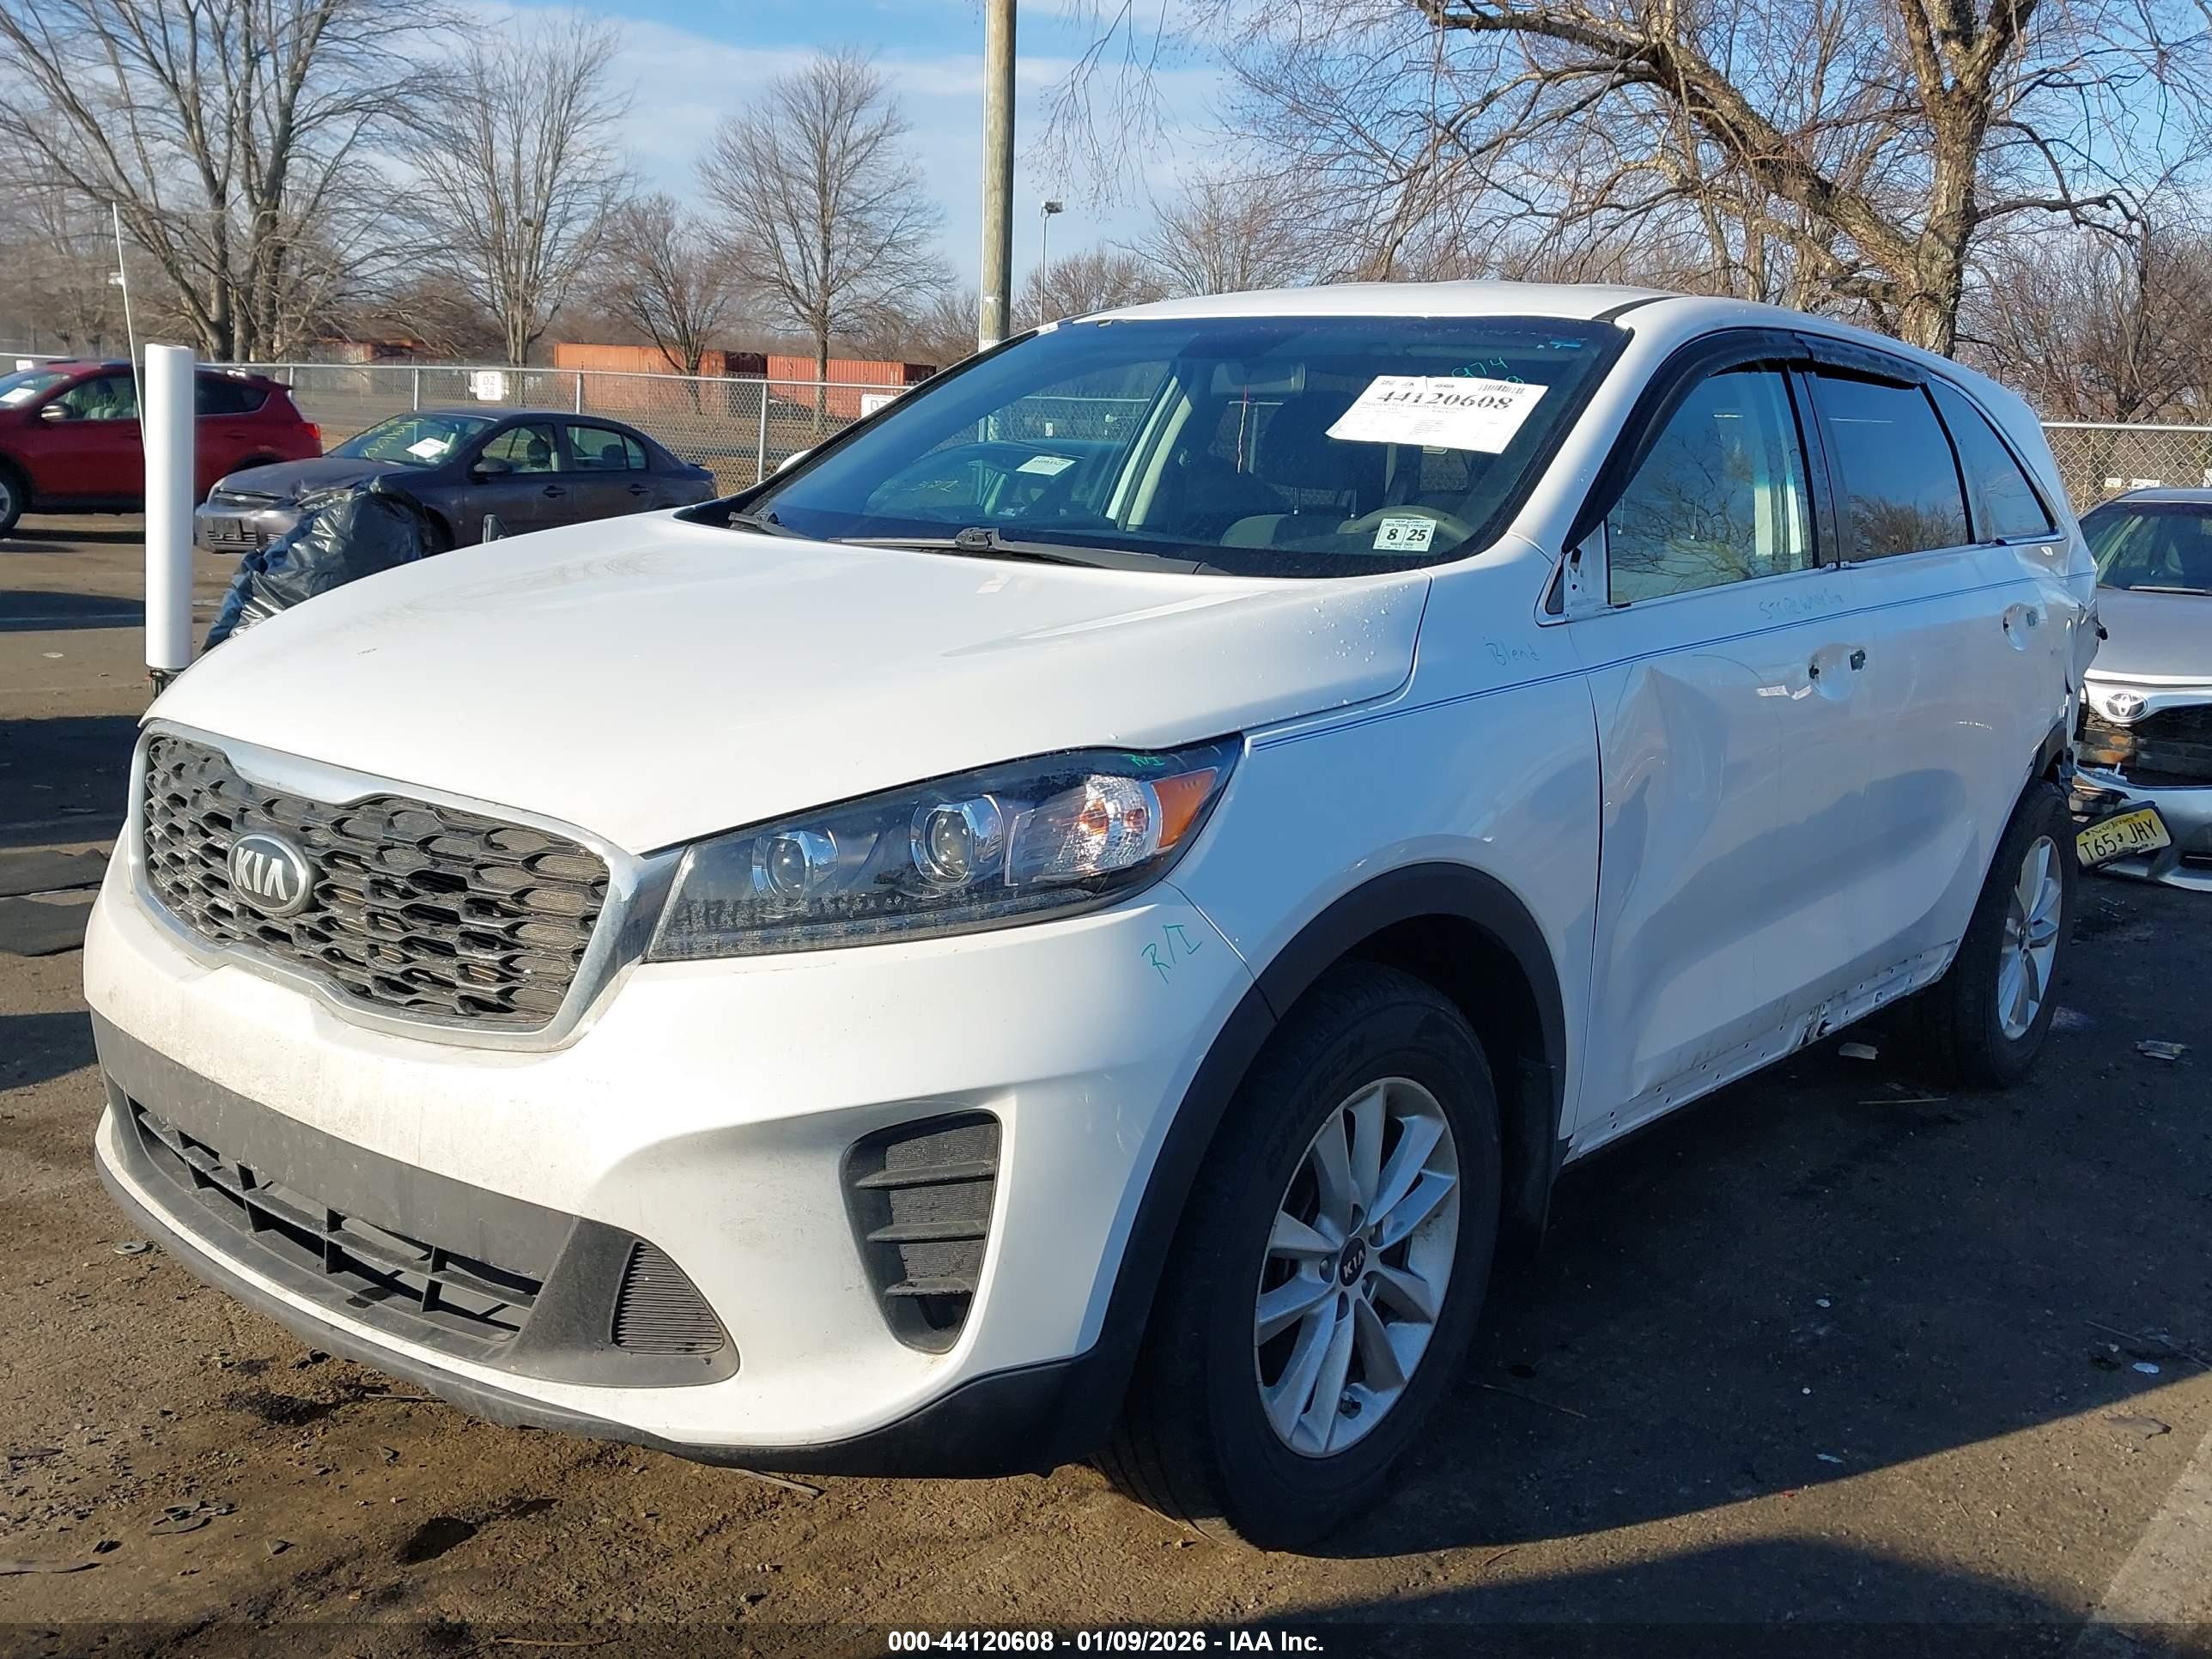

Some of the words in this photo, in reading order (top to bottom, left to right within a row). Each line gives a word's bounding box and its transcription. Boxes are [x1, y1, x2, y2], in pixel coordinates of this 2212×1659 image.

[870, 399, 888, 411] D
[1377, 390, 1515, 410] 44120608
[1386, 528, 1399, 540] 8
[1406, 529, 1427, 541] 25
[2080, 833, 2117, 860] T65
[2129, 818, 2158, 844] JHY
[235, 846, 288, 901] KIA
[1343, 1249, 1364, 1279] KIA
